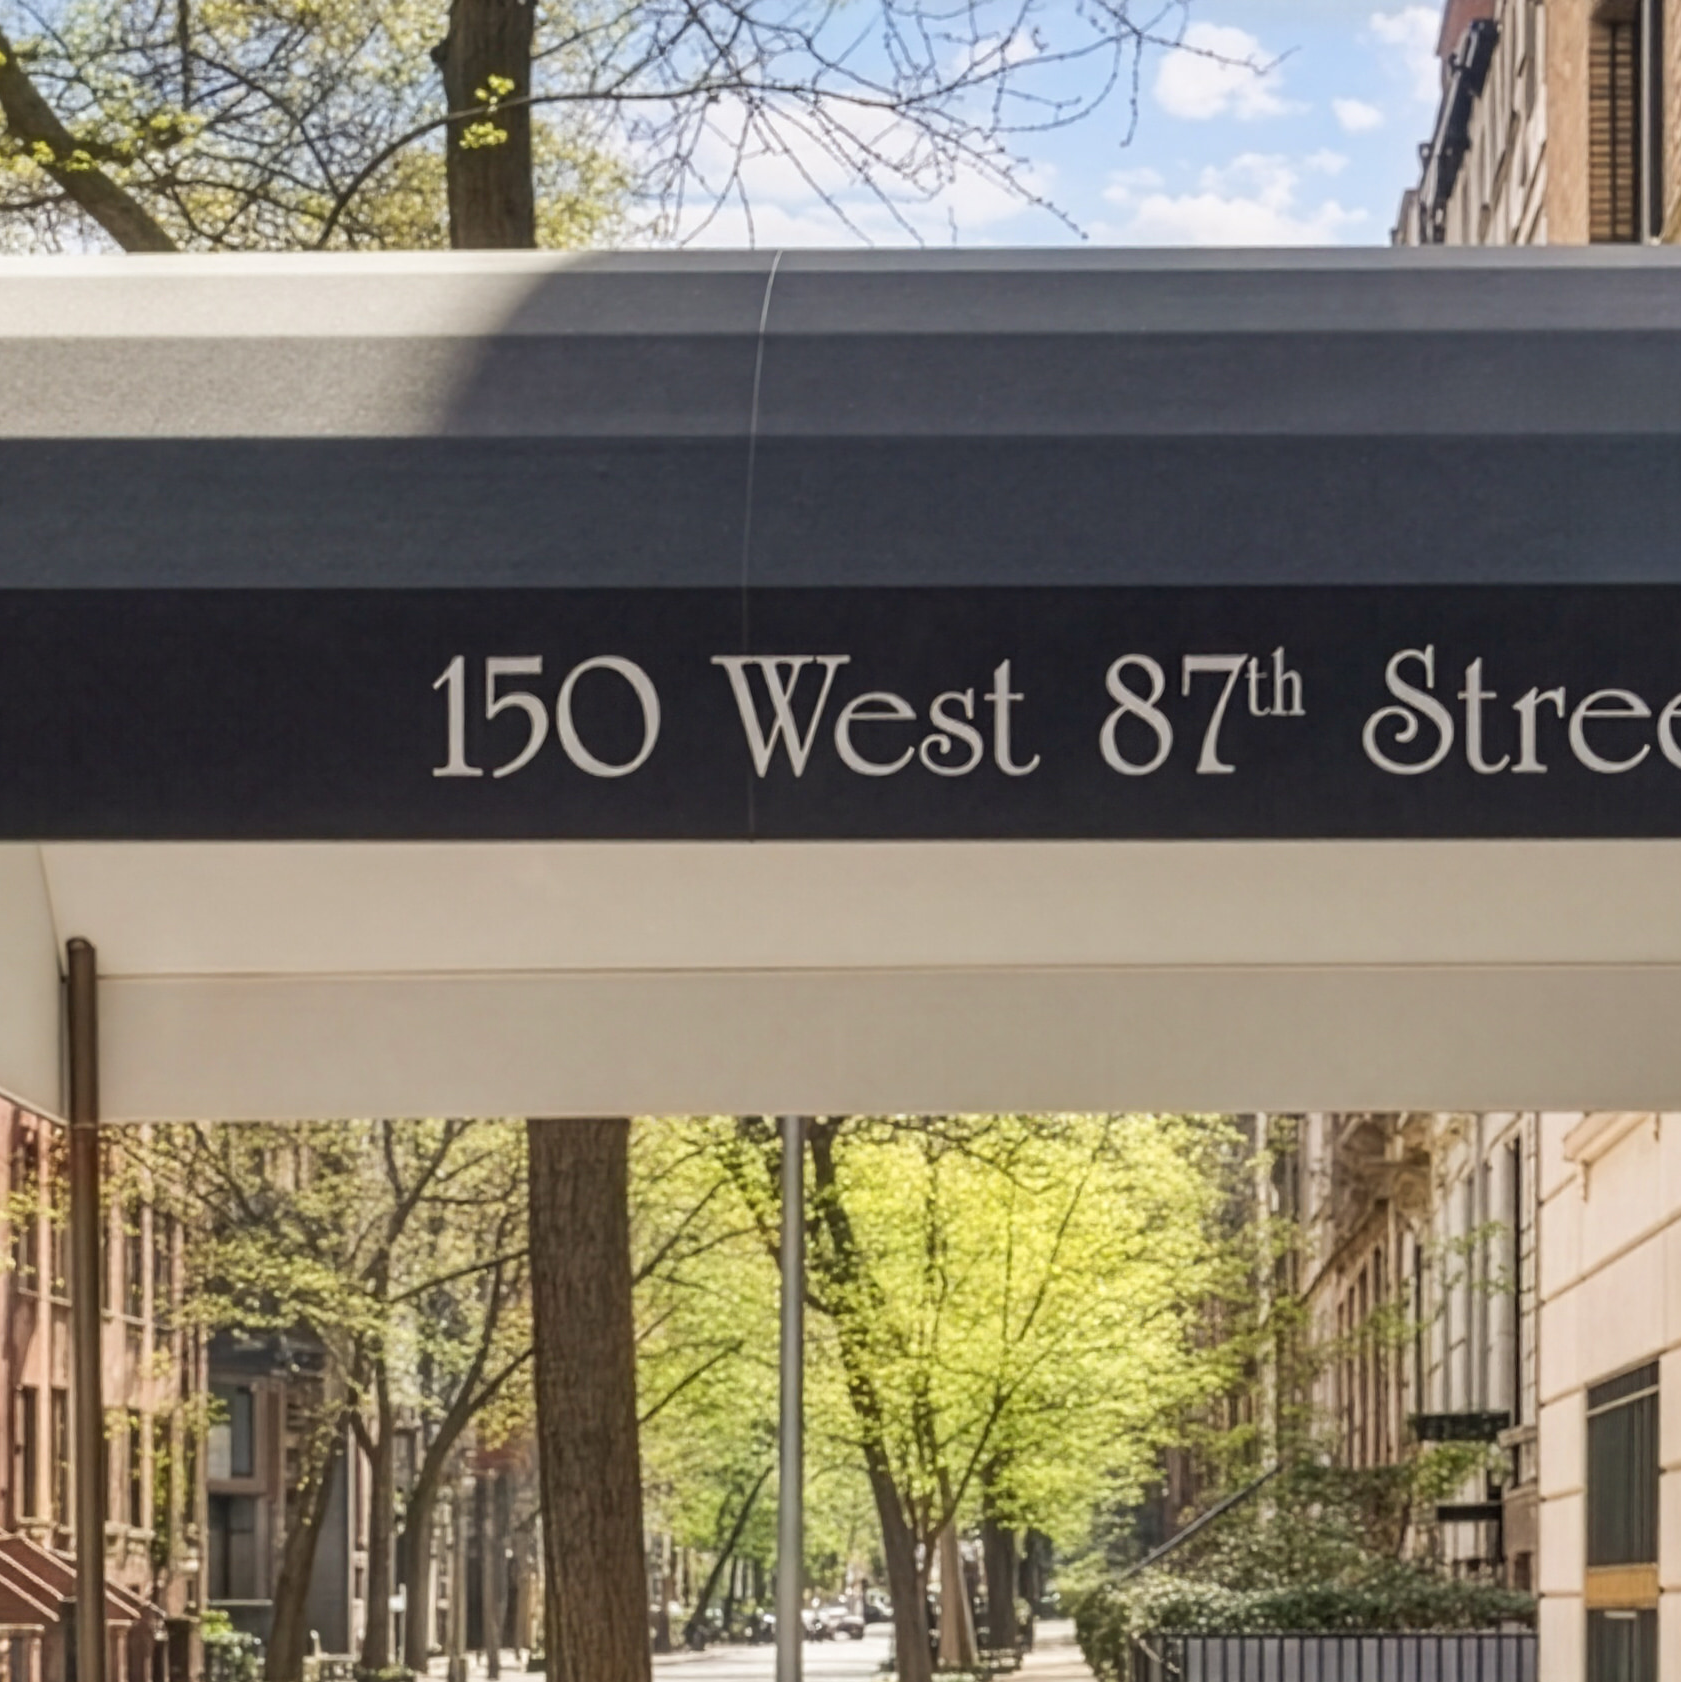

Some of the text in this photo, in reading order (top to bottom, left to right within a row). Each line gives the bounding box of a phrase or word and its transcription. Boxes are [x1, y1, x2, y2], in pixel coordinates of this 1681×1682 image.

[430, 655, 661, 778] 150
[710, 654, 1041, 778] West
[1099, 646, 1306, 776] 87th
